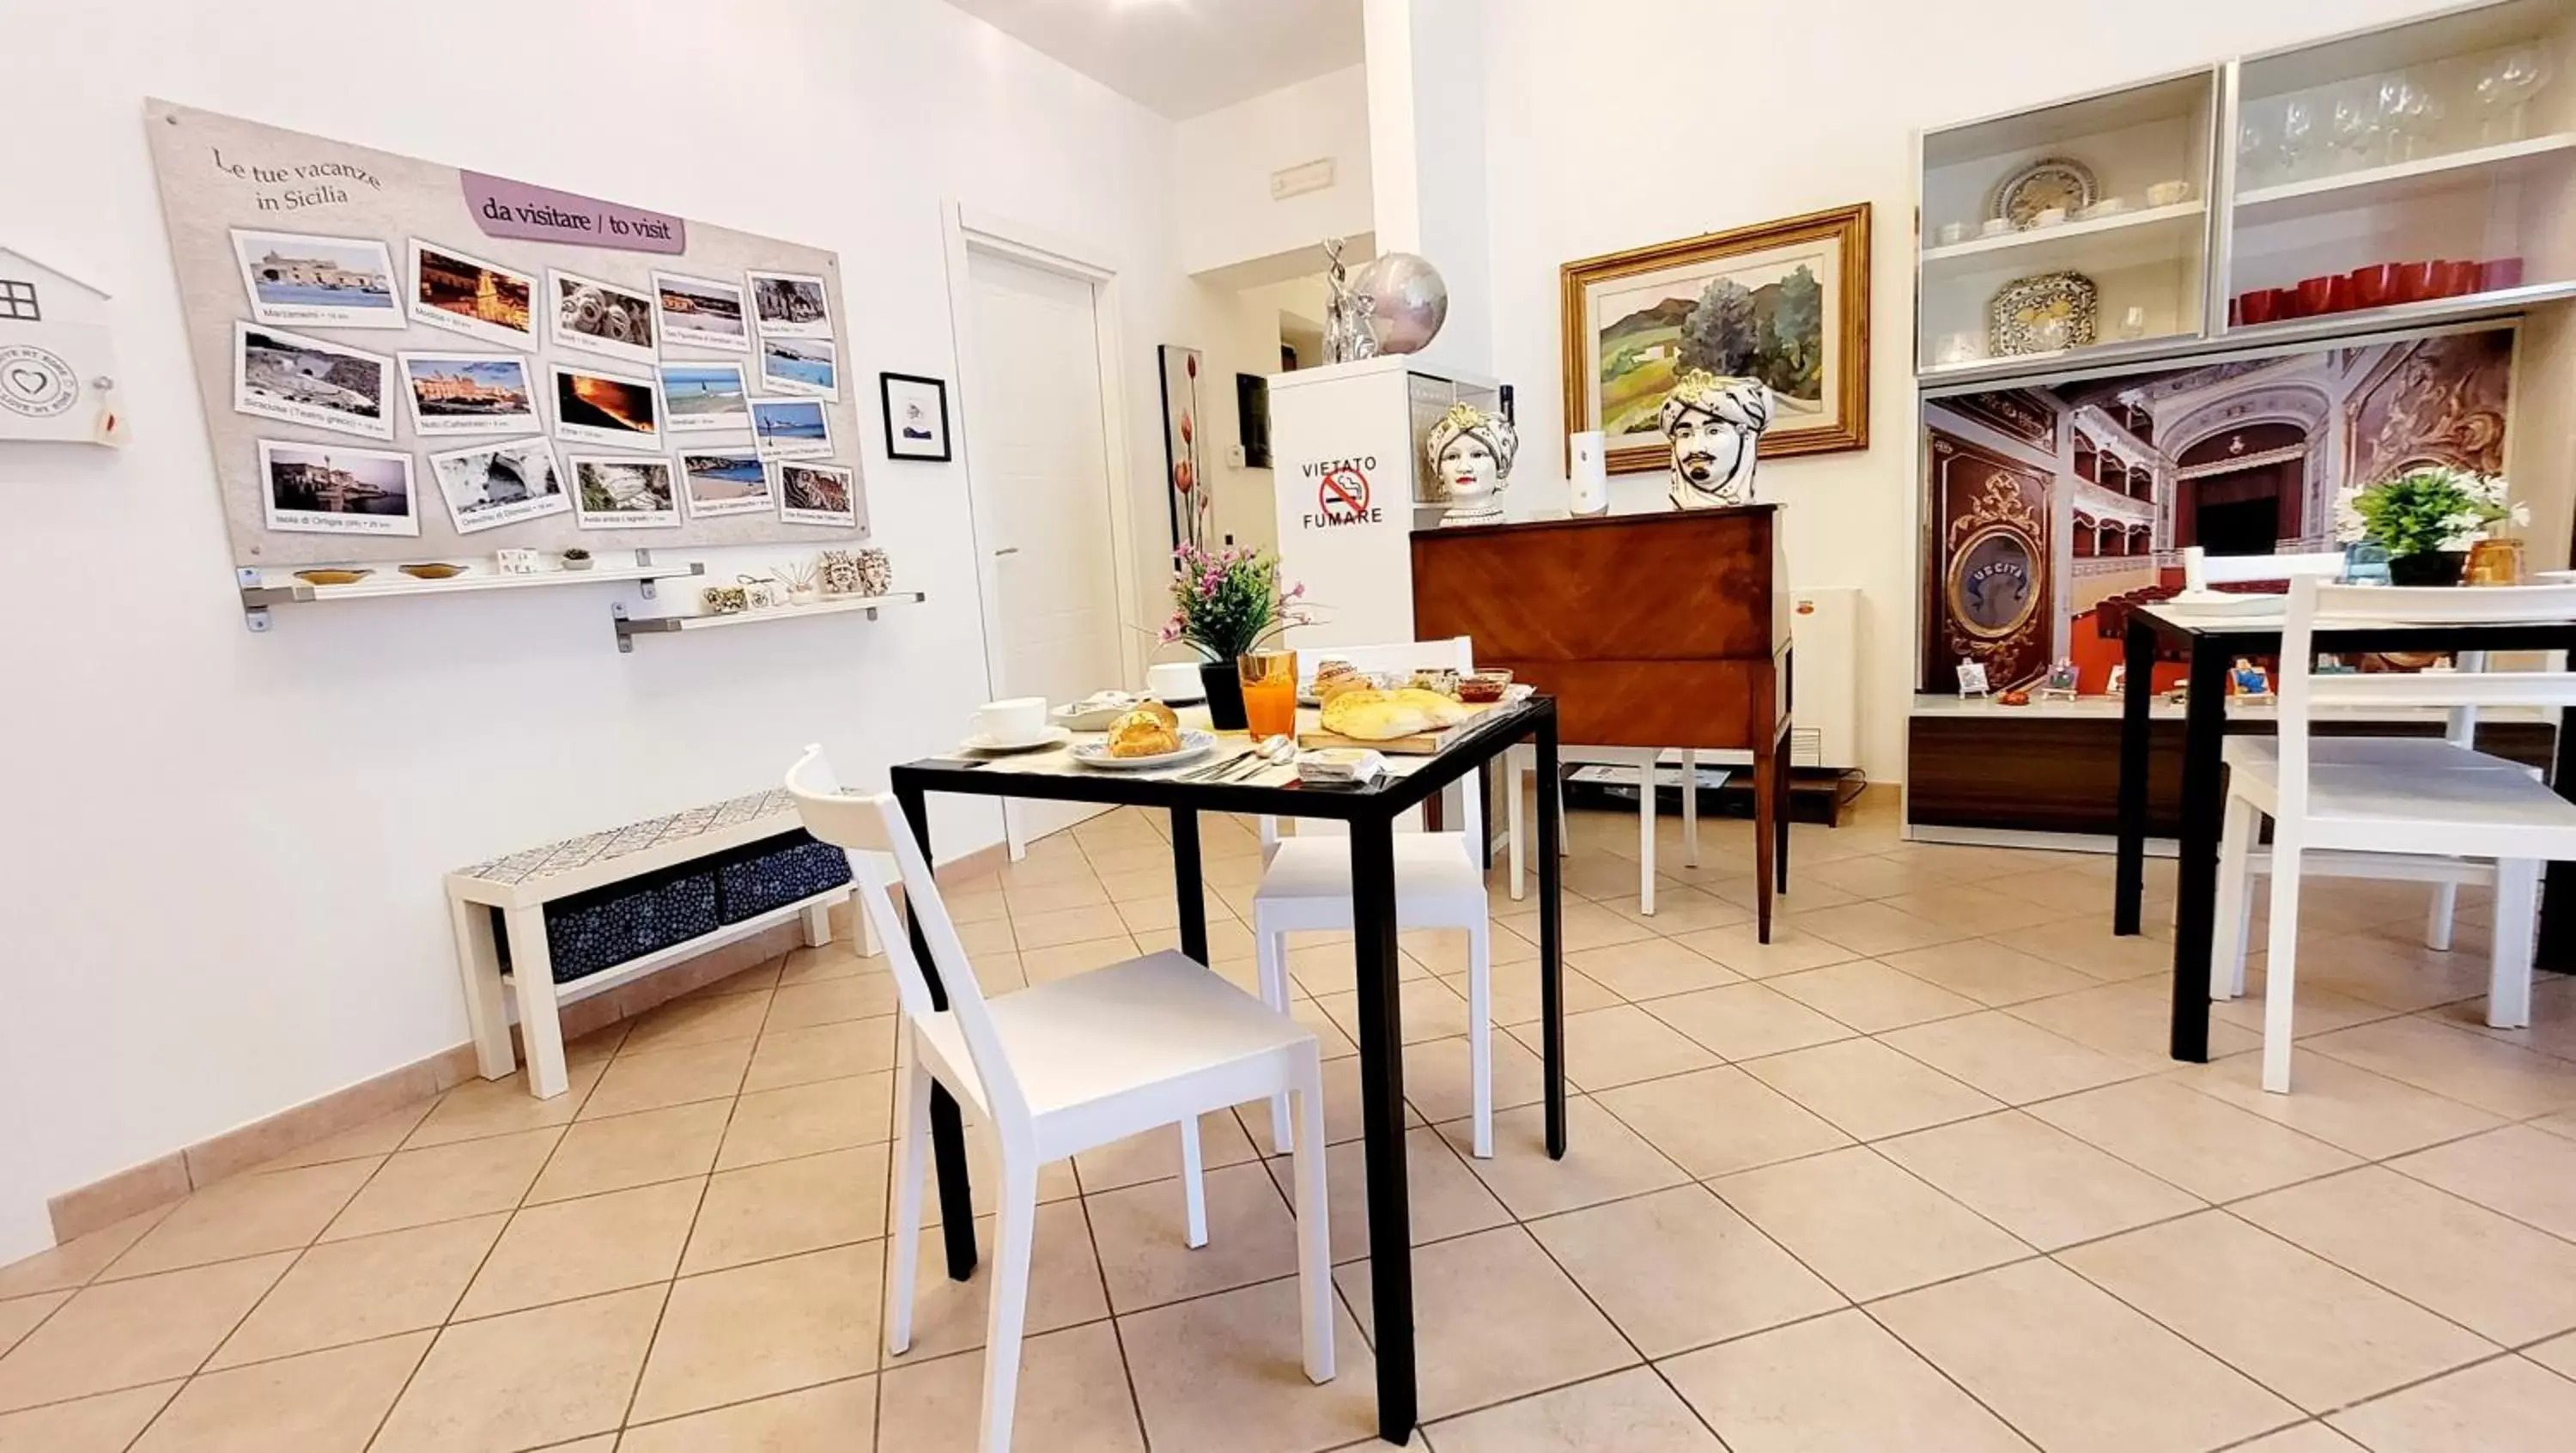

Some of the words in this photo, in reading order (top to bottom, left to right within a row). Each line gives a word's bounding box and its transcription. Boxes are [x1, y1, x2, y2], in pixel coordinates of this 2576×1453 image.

[212, 146, 246, 179] Le
[252, 165, 289, 183] tue
[295, 162, 383, 192] vacanze
[256, 192, 280, 210] in
[283, 185, 349, 210] Sicilia
[483, 197, 513, 222] da
[516, 204, 592, 231] visitare
[610, 216, 629, 234] to
[631, 218, 672, 240] visit
[1303, 456, 1377, 477] VIETATO
[1303, 508, 1382, 529] FUMARE
[1974, 562, 2022, 580] USCITA
